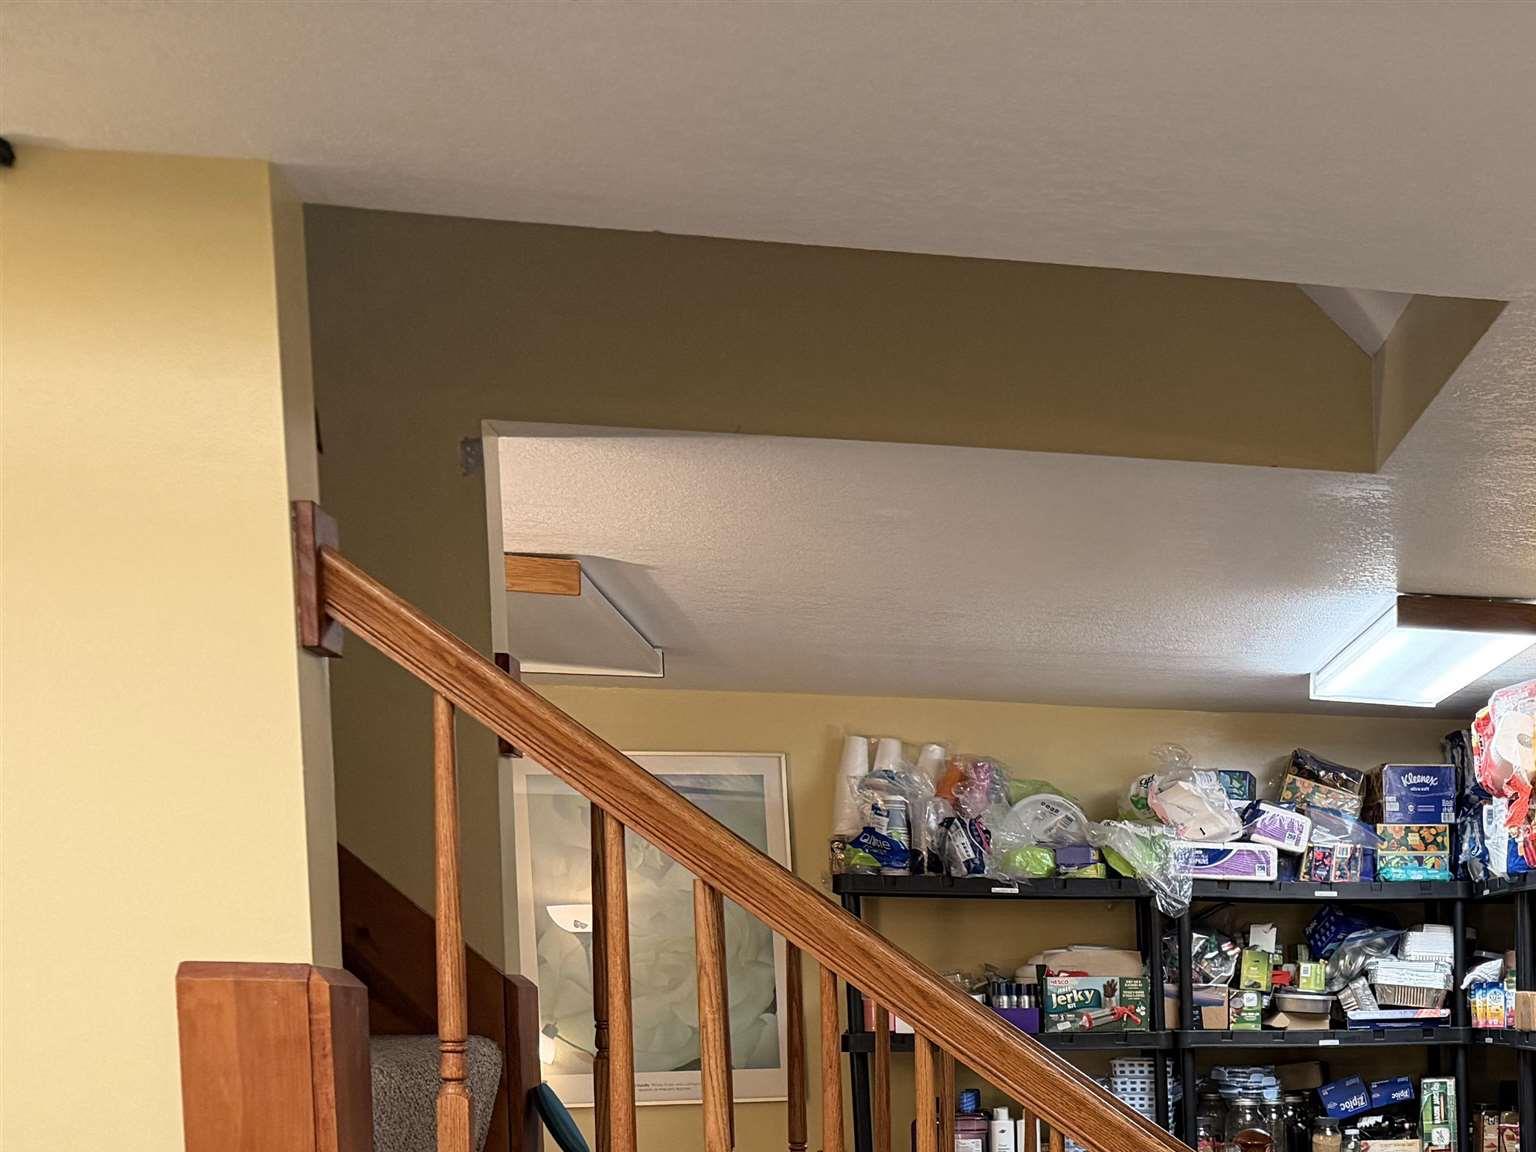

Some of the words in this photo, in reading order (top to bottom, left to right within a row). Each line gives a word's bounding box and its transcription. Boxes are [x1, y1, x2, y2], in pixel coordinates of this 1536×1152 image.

[1401, 772, 1439, 787] Kleenex
[1051, 988, 1095, 1009] Jerky
[1339, 1091, 1368, 1112] Ziploc
[1391, 1087, 1411, 1101] Ziploc
